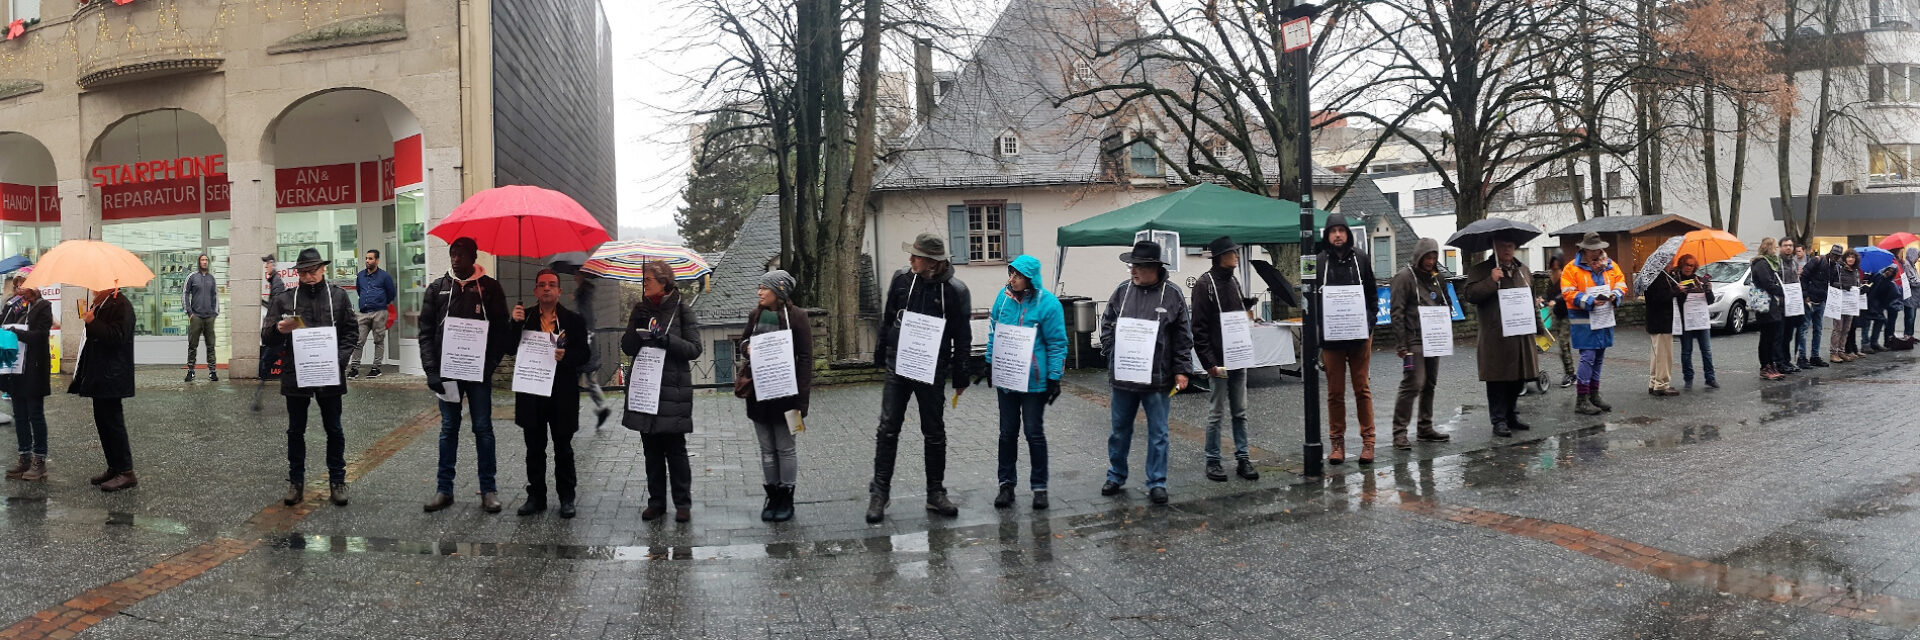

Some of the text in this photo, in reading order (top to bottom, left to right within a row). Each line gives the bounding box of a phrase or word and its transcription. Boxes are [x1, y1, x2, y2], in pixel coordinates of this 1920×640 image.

[92, 154, 224, 187] STARPHONE
[2, 193, 34, 212] HANDY
[103, 185, 197, 210] REPARATUR
[275, 185, 350, 205] VERKAUF
[40, 287, 61, 296] GELD
